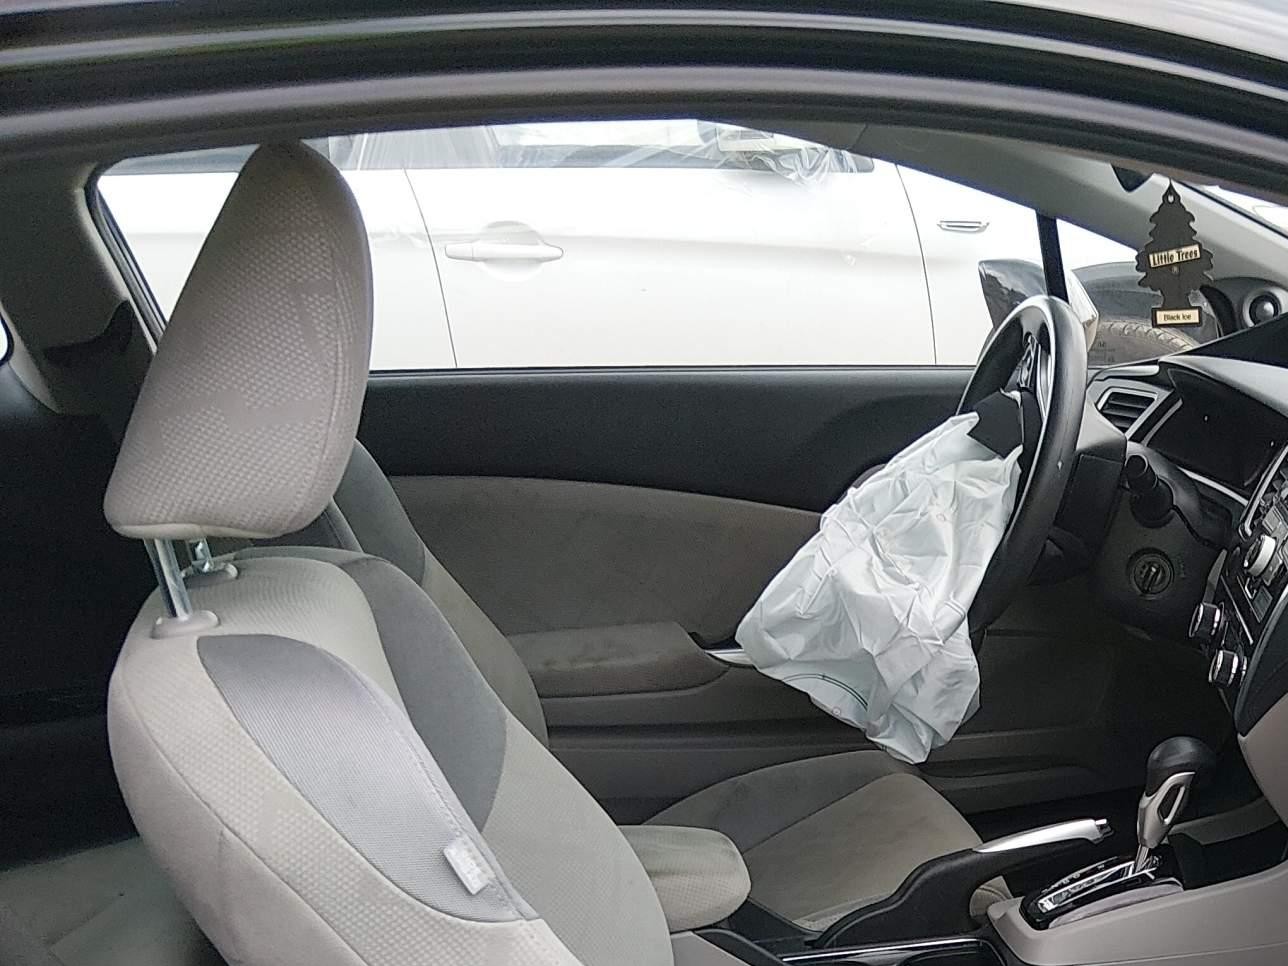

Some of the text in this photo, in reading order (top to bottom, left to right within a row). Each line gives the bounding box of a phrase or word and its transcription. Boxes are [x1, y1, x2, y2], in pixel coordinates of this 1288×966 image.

[1152, 248, 1198, 266] Little Trees
[1163, 313, 1181, 321] Black
